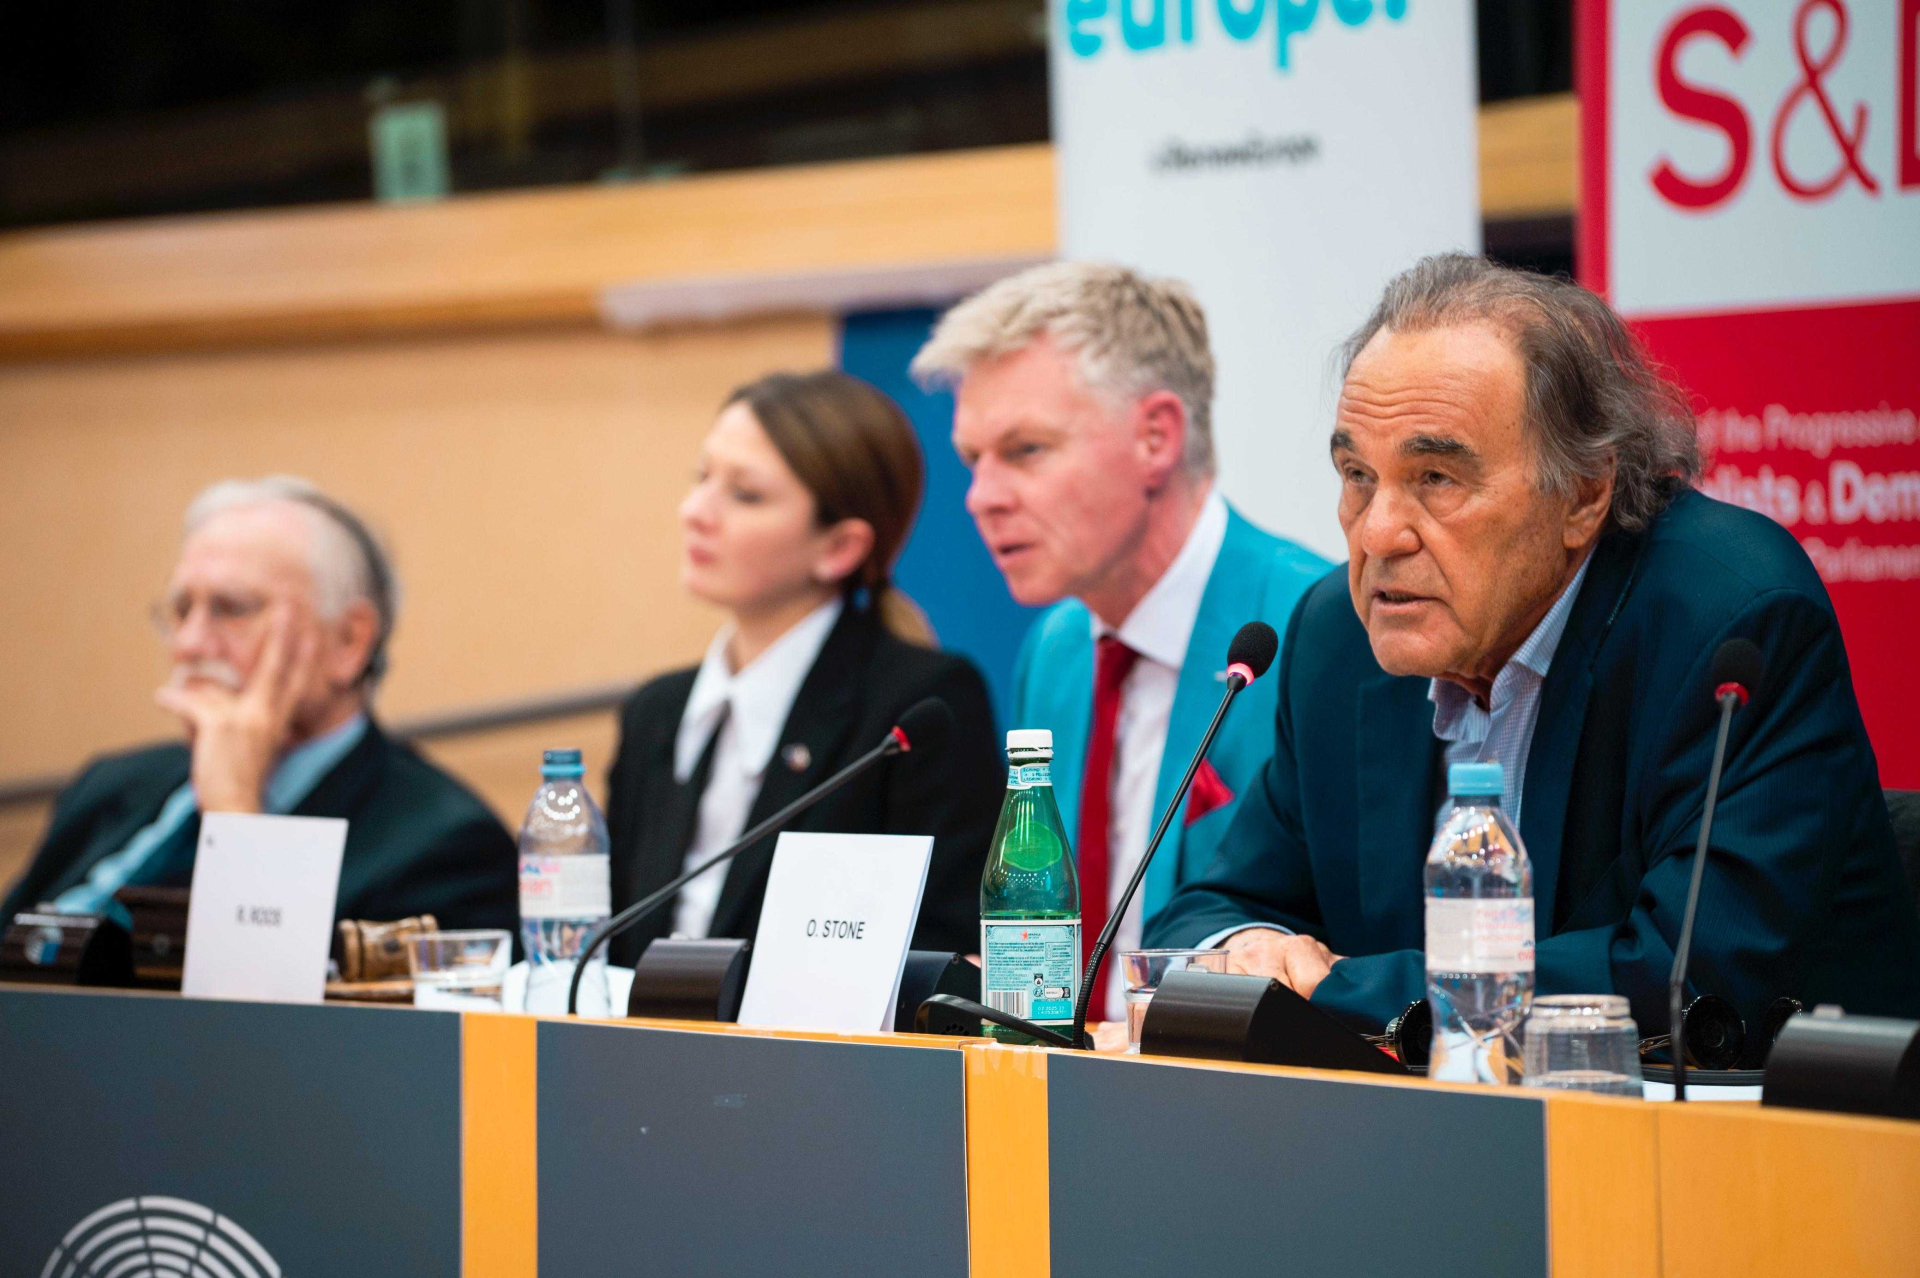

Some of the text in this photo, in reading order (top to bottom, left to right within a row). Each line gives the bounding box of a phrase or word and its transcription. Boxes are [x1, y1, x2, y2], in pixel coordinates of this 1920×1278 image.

[1649, 0, 1920, 211] S&
[1762, 402, 1917, 459] Progressive
[806, 919, 866, 940] O. STONE
